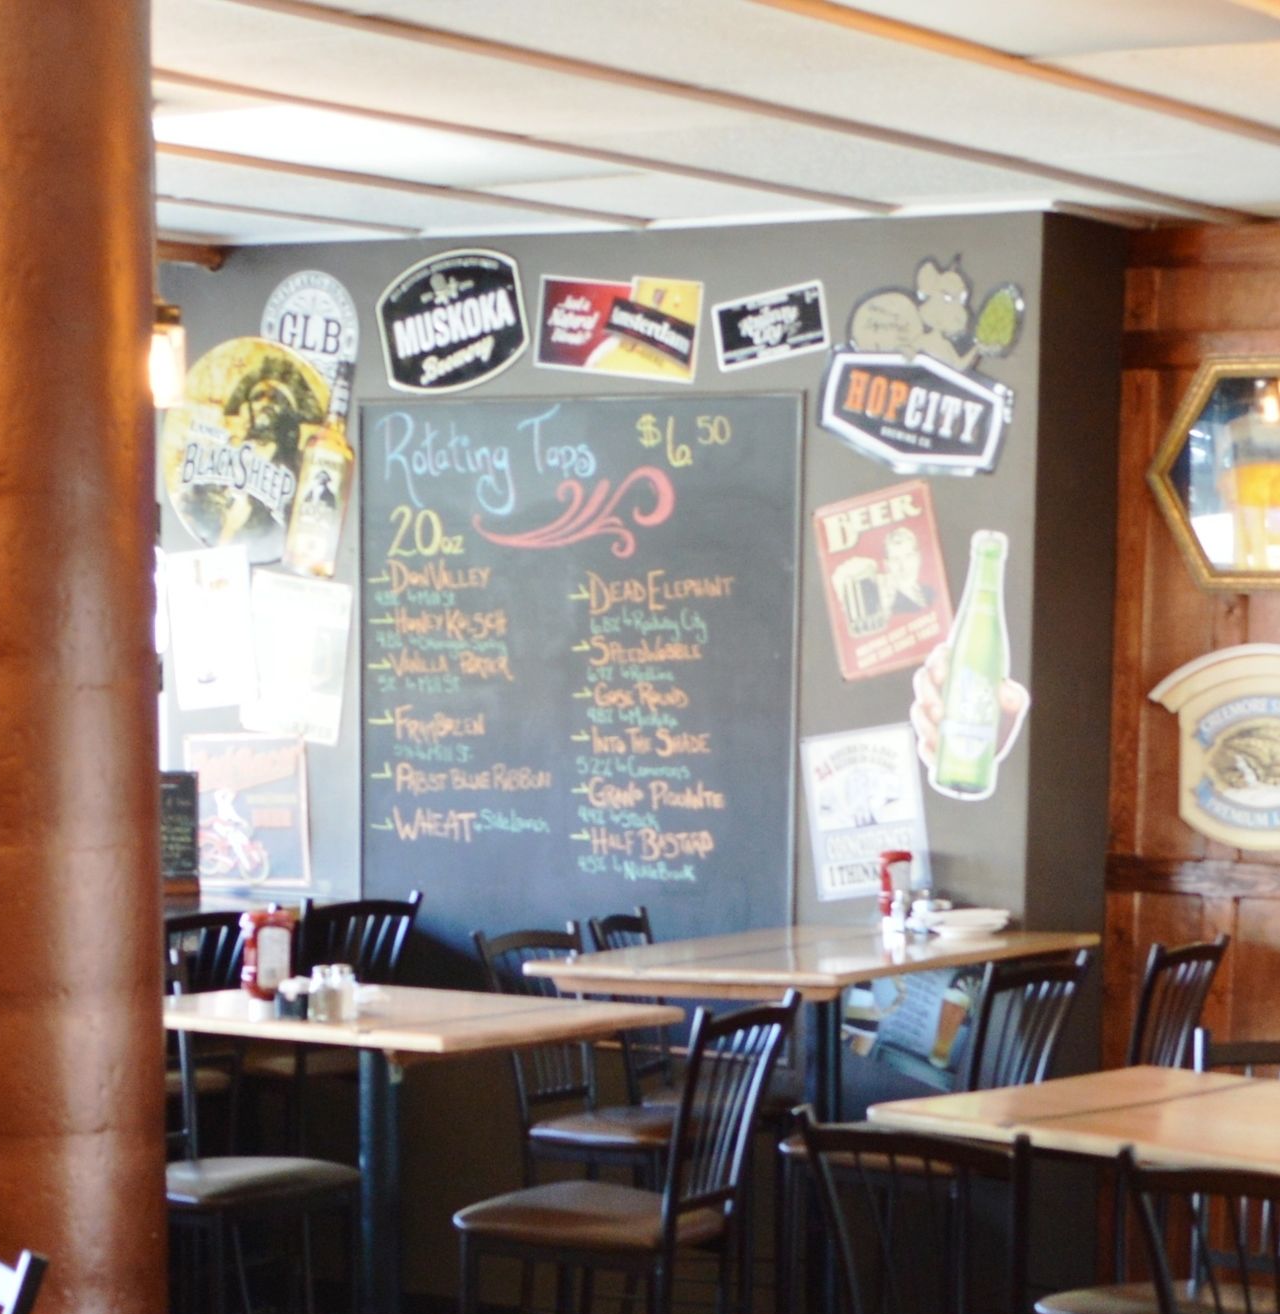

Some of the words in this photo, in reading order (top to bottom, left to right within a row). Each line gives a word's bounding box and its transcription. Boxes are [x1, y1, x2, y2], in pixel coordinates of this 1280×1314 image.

[279, 312, 343, 355] GLB
[393, 287, 516, 359] MUSKOKA
[843, 368, 911, 422] HOP
[904, 386, 985, 444] CITY
[234, 445, 296, 511] SHEEP
[377, 411, 516, 516] Rotating
[519, 404, 598, 478] Taps
[823, 494, 922, 553] BEER
[586, 570, 646, 615] DEAD
[393, 806, 477, 843] WHEAT
